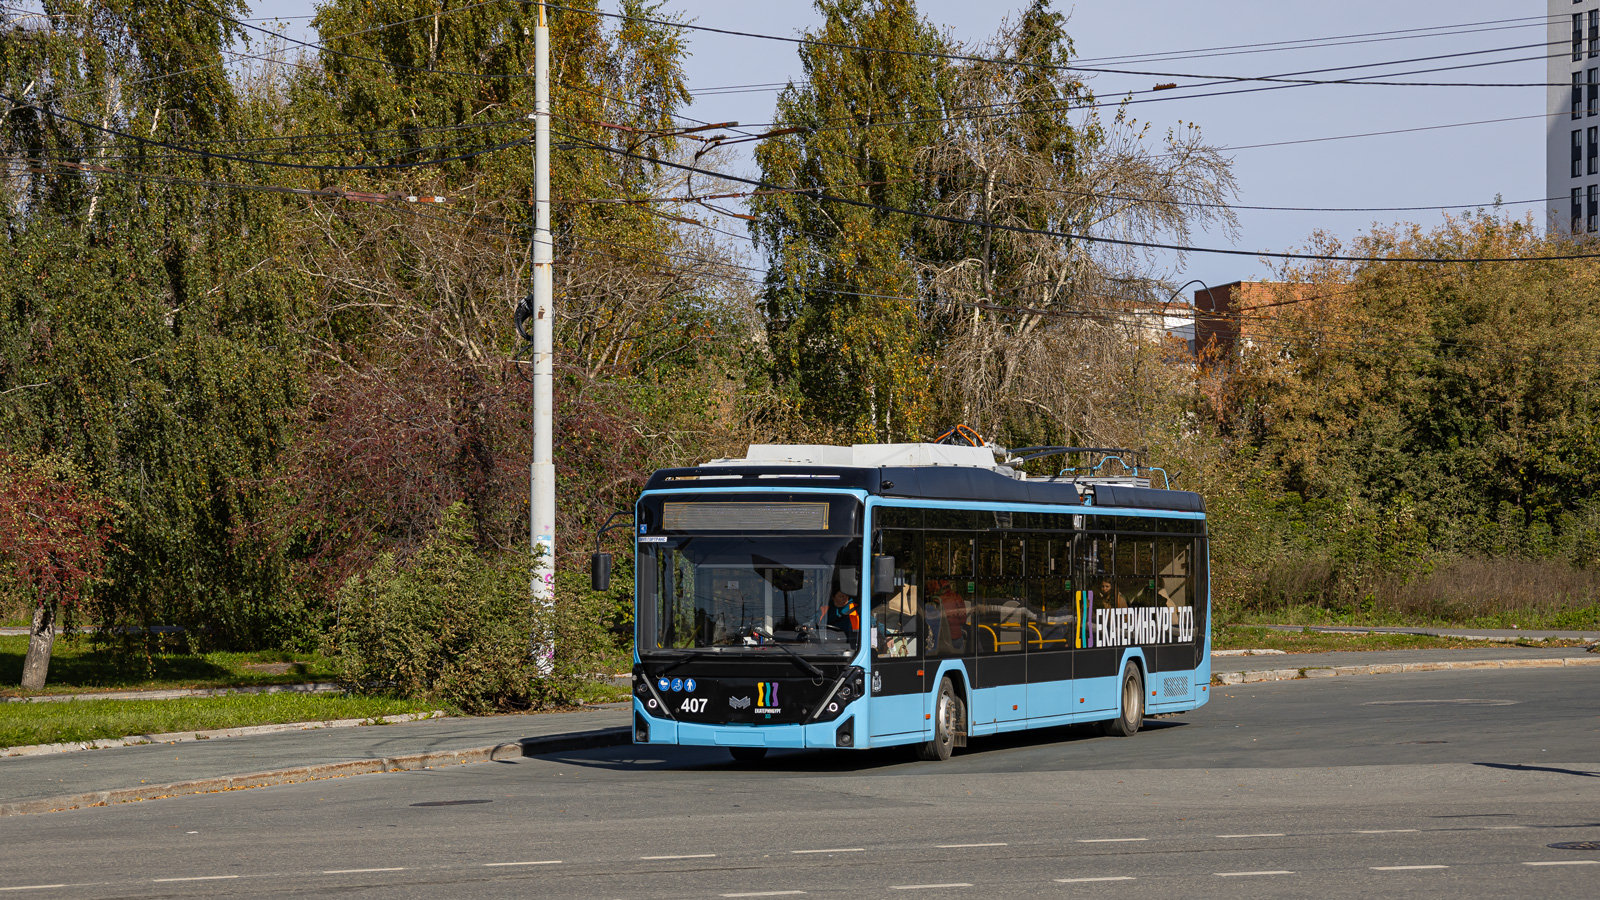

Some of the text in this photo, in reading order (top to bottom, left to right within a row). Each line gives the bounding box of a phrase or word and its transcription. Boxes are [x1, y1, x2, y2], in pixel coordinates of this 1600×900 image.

[1096, 606, 1194, 647] ЕКАТЕРИНБУРГ 300
[680, 698, 708, 713] 407
